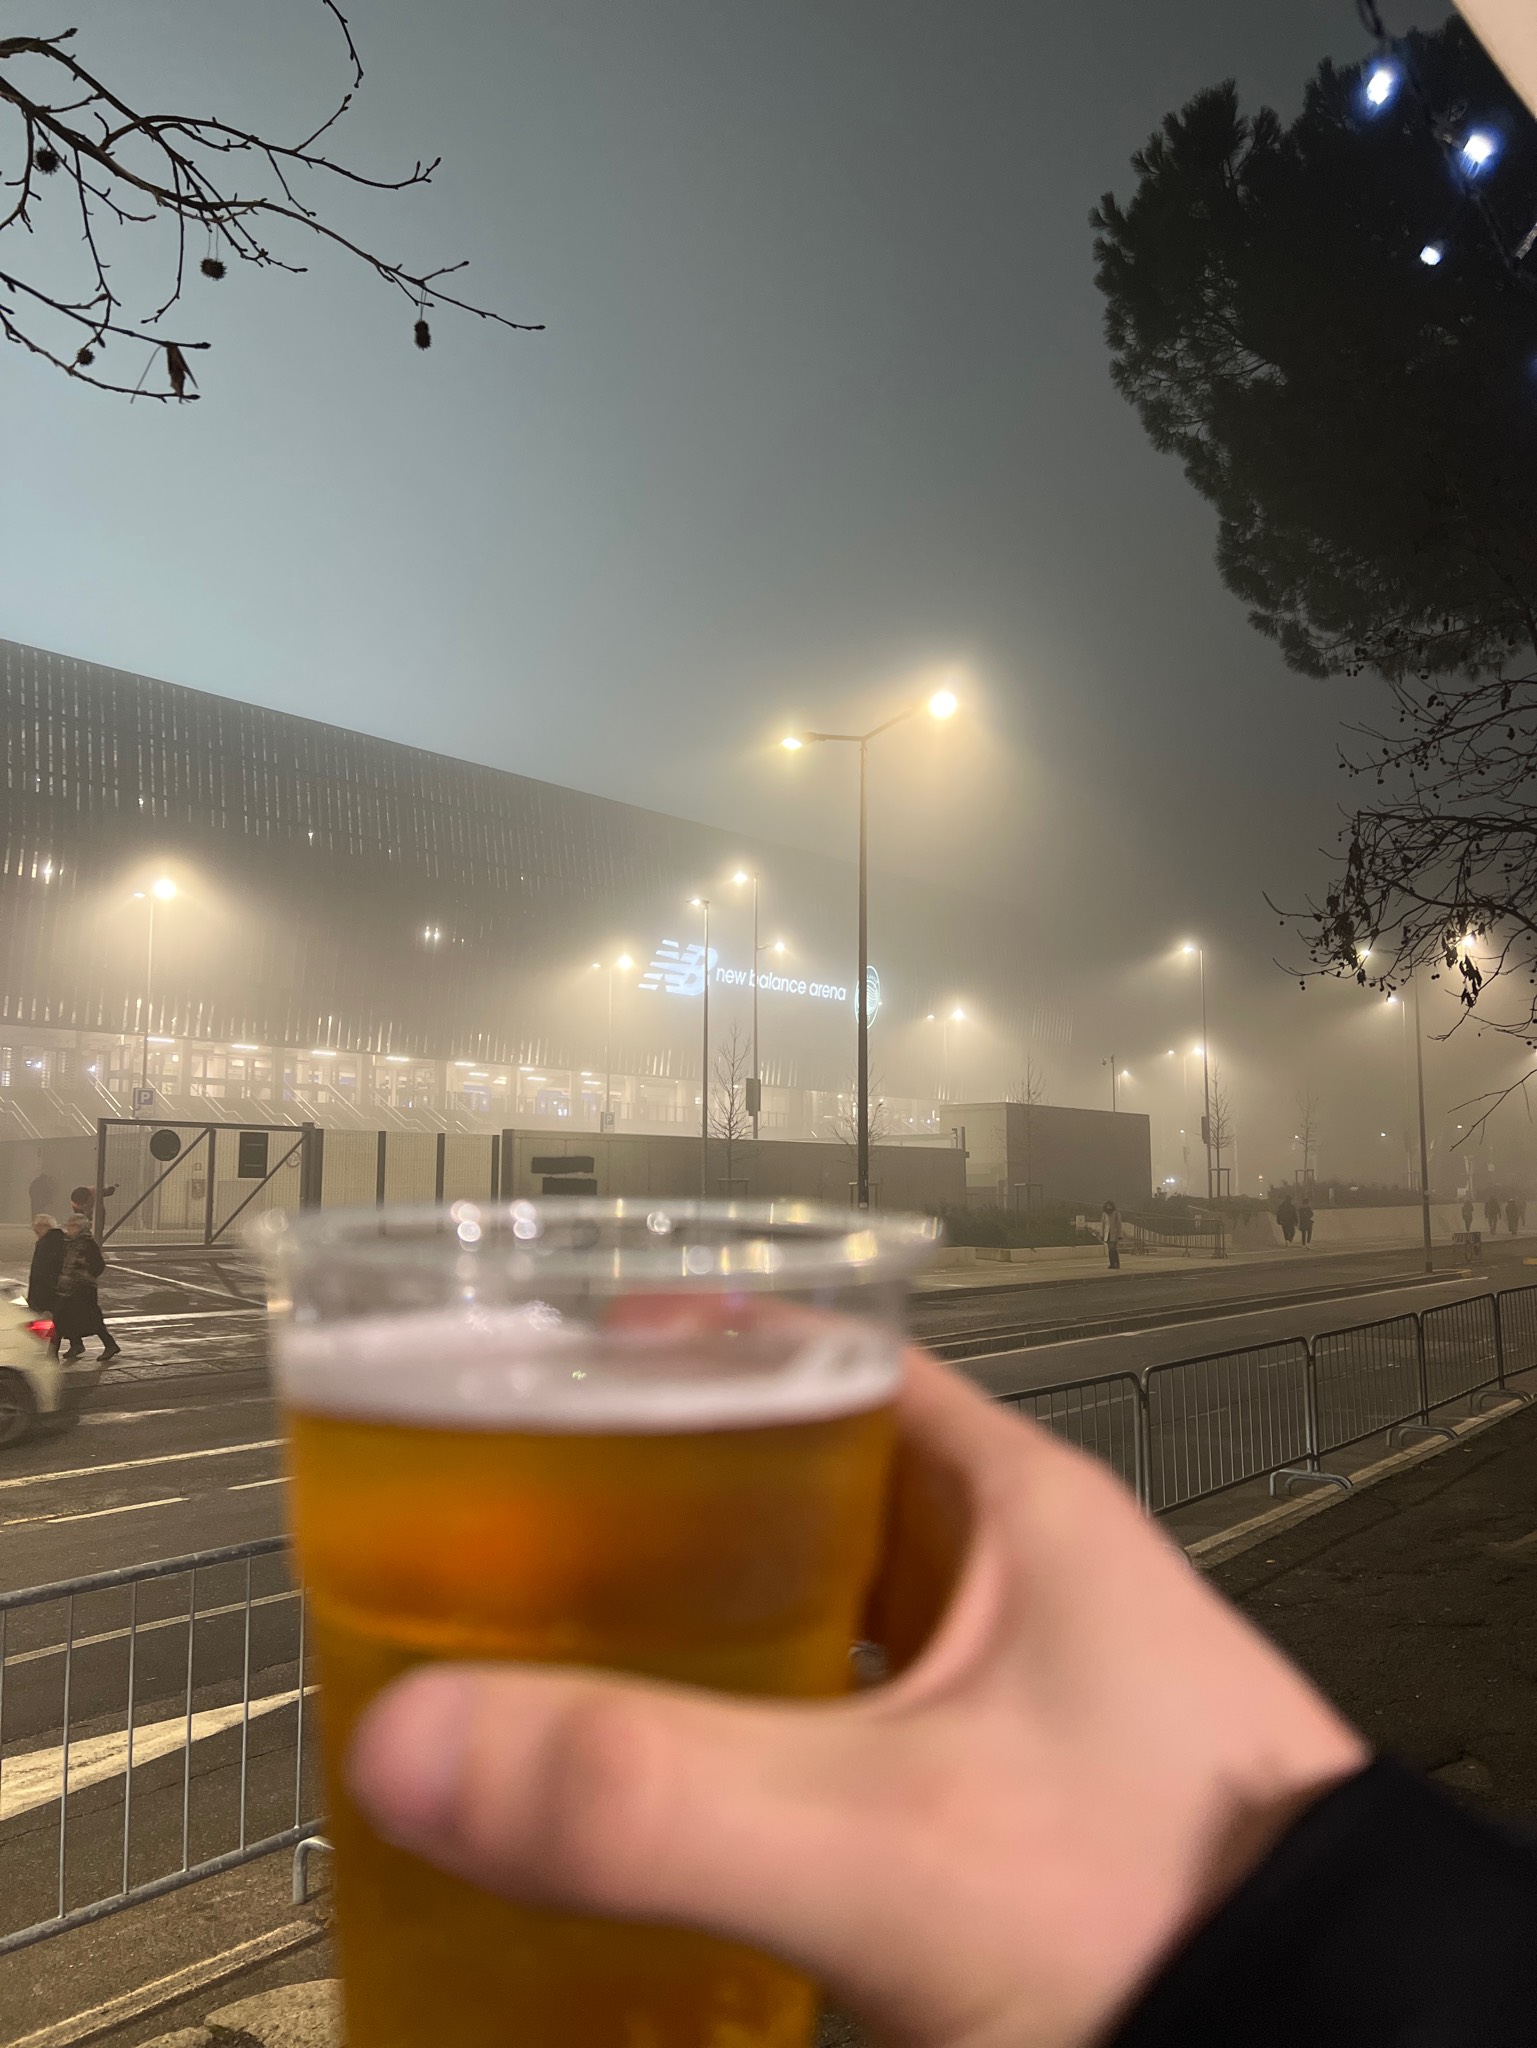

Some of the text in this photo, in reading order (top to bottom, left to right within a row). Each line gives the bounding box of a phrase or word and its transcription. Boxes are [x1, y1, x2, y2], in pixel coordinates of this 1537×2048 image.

[716, 967, 847, 1000] new balance arena
[141, 1091, 151, 1103] P
